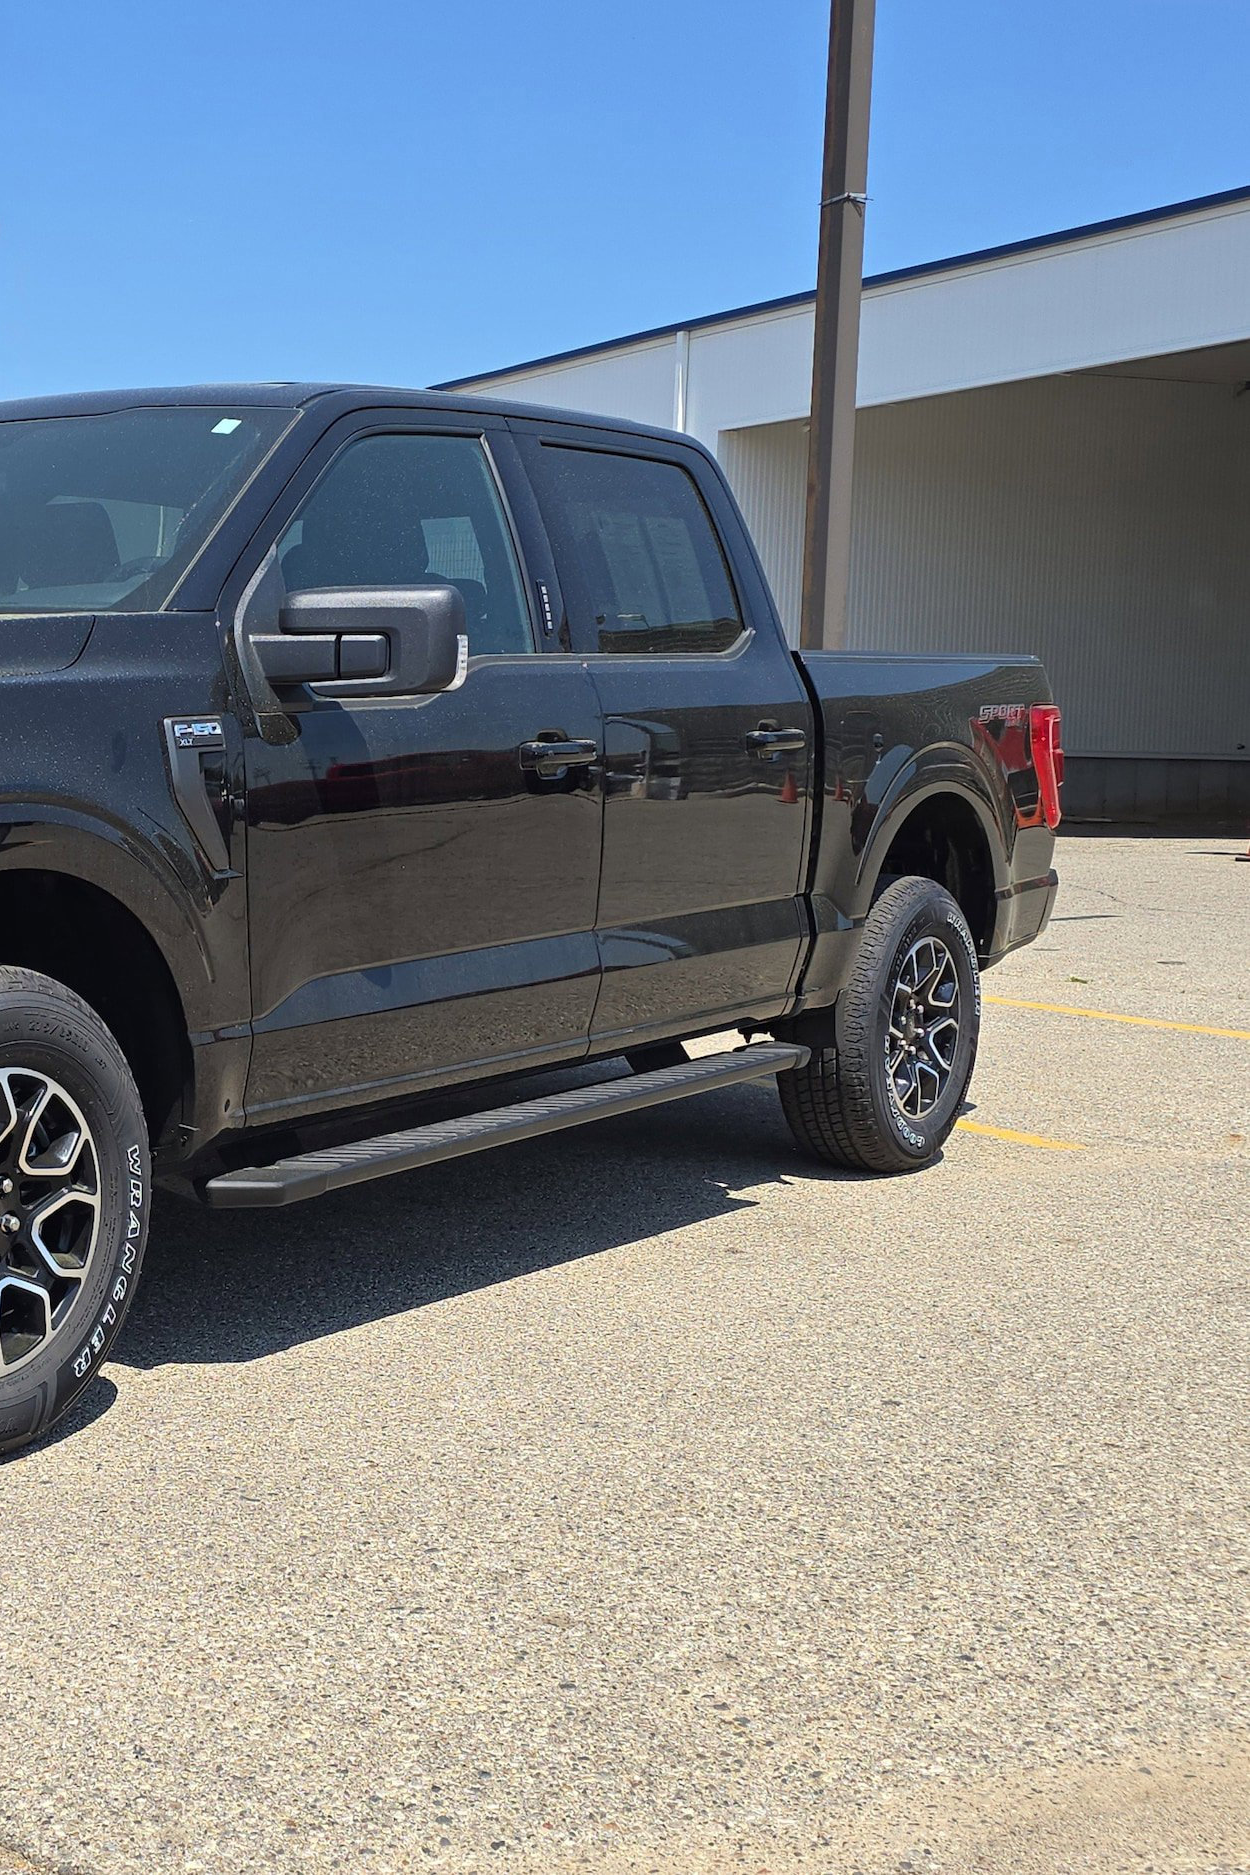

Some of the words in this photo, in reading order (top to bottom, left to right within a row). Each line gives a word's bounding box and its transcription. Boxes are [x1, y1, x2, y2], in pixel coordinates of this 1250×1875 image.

[978, 703, 1025, 724] SPORT
[174, 722, 222, 737] F-150
[73, 1144, 143, 1378] WRANGLER
